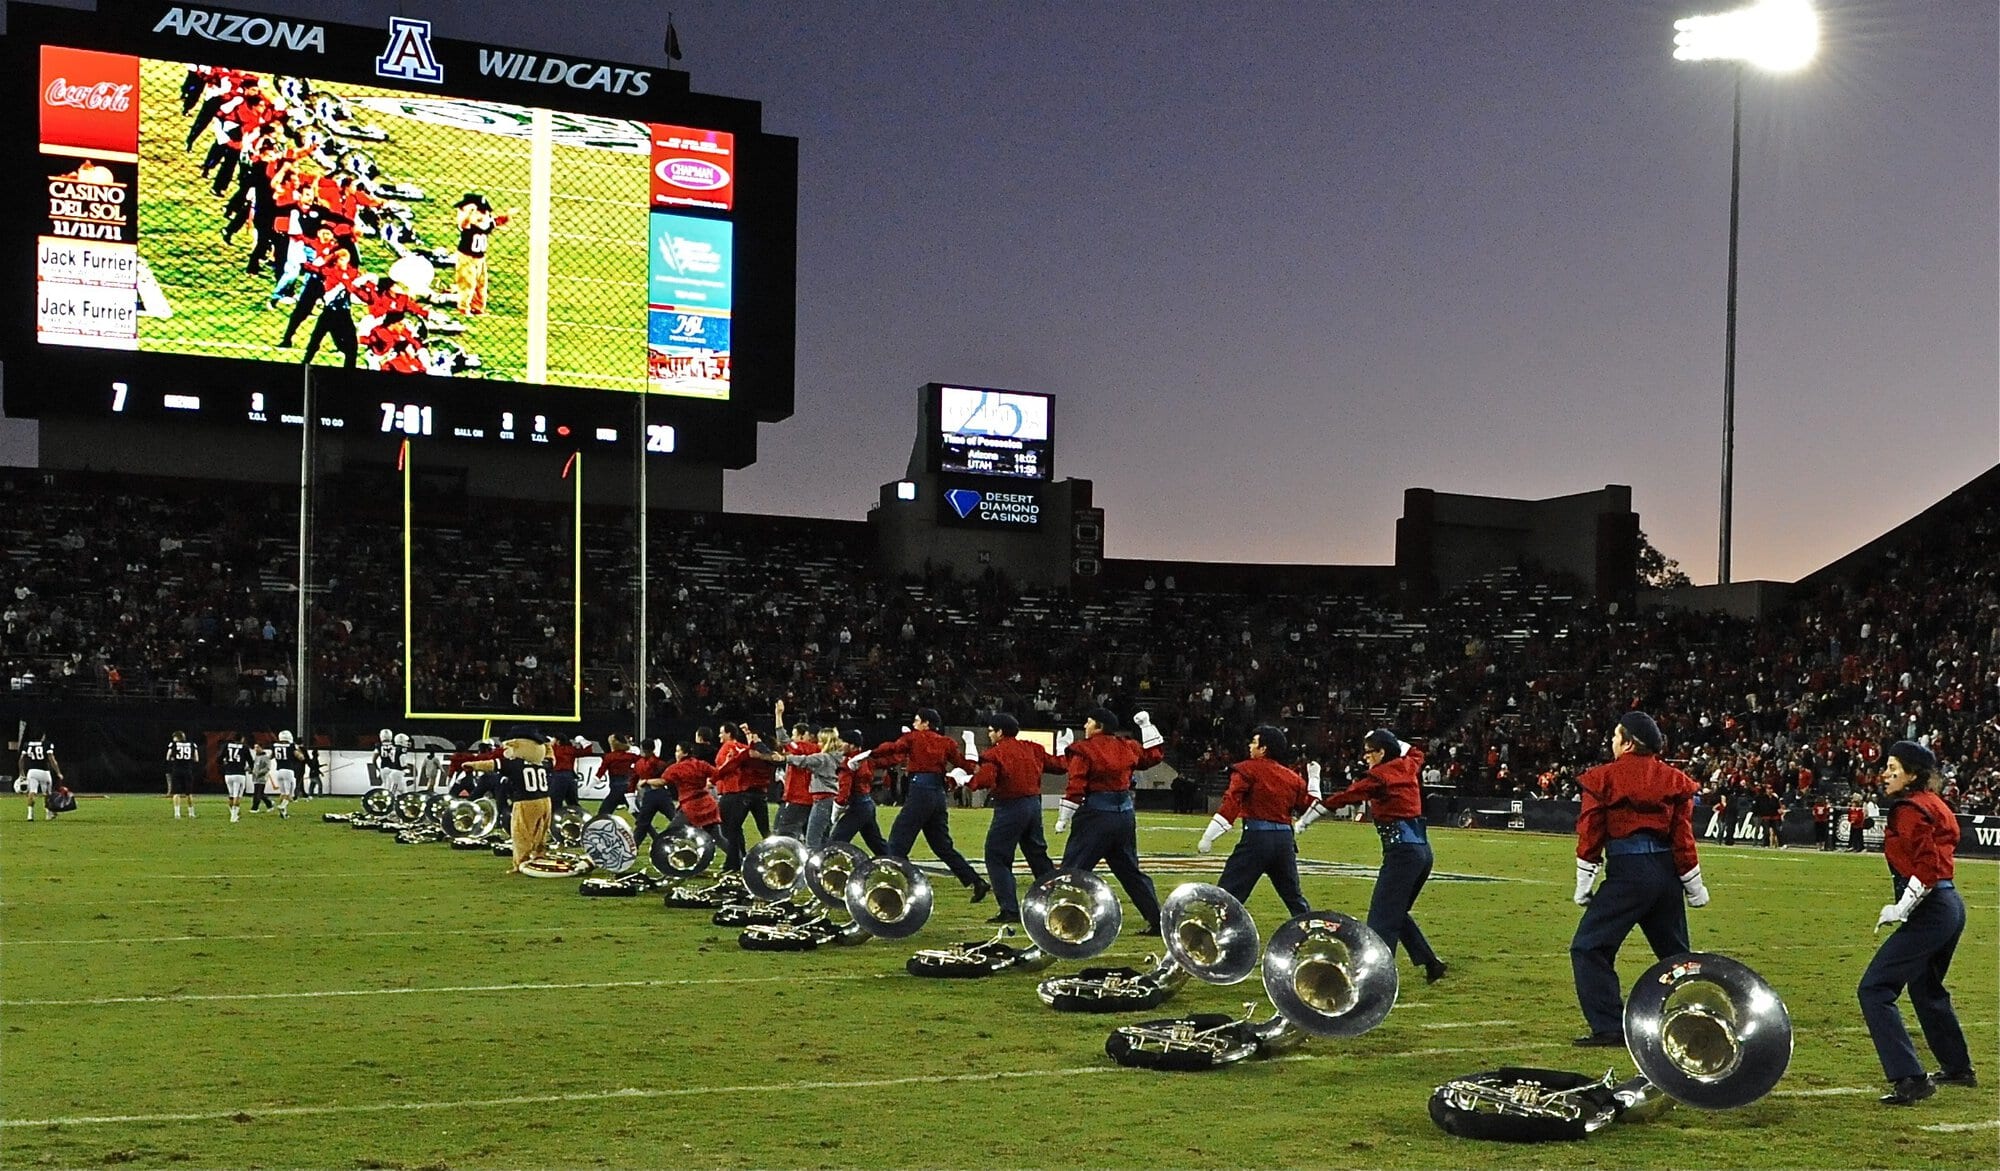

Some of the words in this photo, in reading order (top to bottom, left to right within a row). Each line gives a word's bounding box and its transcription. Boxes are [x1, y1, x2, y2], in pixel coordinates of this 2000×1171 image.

[152, 7, 326, 54] ARIZONA
[376, 16, 443, 84] A
[478, 49, 652, 97] WILDCATS
[45, 78, 133, 112] Coca-Cola
[49, 182, 126, 203] CASINO
[50, 199, 88, 218] DEL
[89, 204, 126, 222] SOL
[53, 220, 122, 241] 11/11/11
[41, 247, 76, 266] Jack
[83, 250, 133, 271] Furrier
[41, 297, 76, 316] Jack
[83, 300, 133, 320] Furrier
[112, 382, 128, 411] 7
[942, 433, 965, 445] Time
[966, 436, 977, 446] of
[967, 460, 992, 470] UTAH
[968, 450, 998, 460] Arizona
[980, 501, 1039, 514] DIAMOND
[986, 492, 1034, 503] DESERT
[981, 511, 1038, 524] CASINOS
[27, 746, 44, 760] 48
[176, 746, 191, 760] 39
[228, 747, 241, 762] 14
[274, 747, 288, 760] 61
[522, 767, 549, 792] 00
